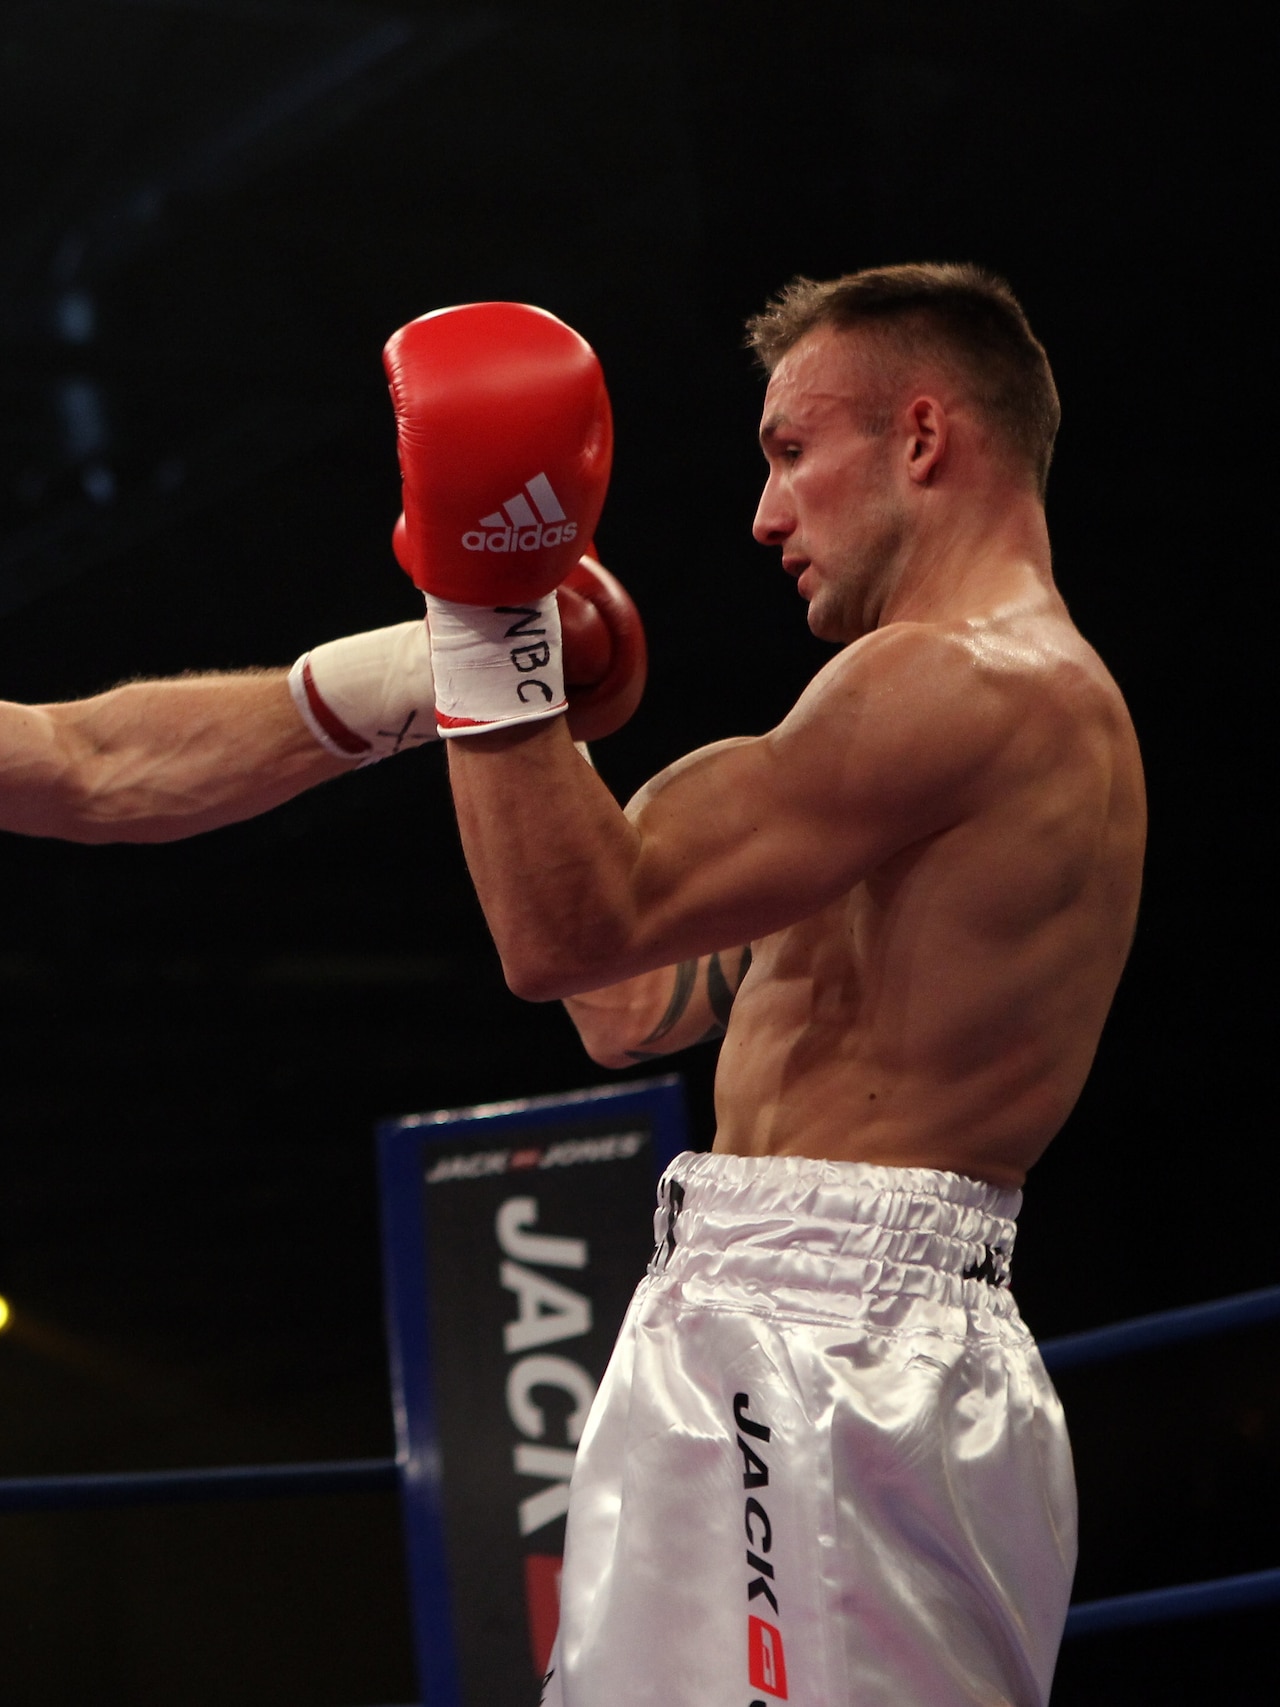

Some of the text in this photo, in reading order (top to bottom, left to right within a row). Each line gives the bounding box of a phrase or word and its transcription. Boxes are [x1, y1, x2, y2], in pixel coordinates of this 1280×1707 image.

[461, 518, 578, 554] adidas
[424, 1130, 648, 1184] JACK JONES
[732, 1391, 780, 1617] JACK
